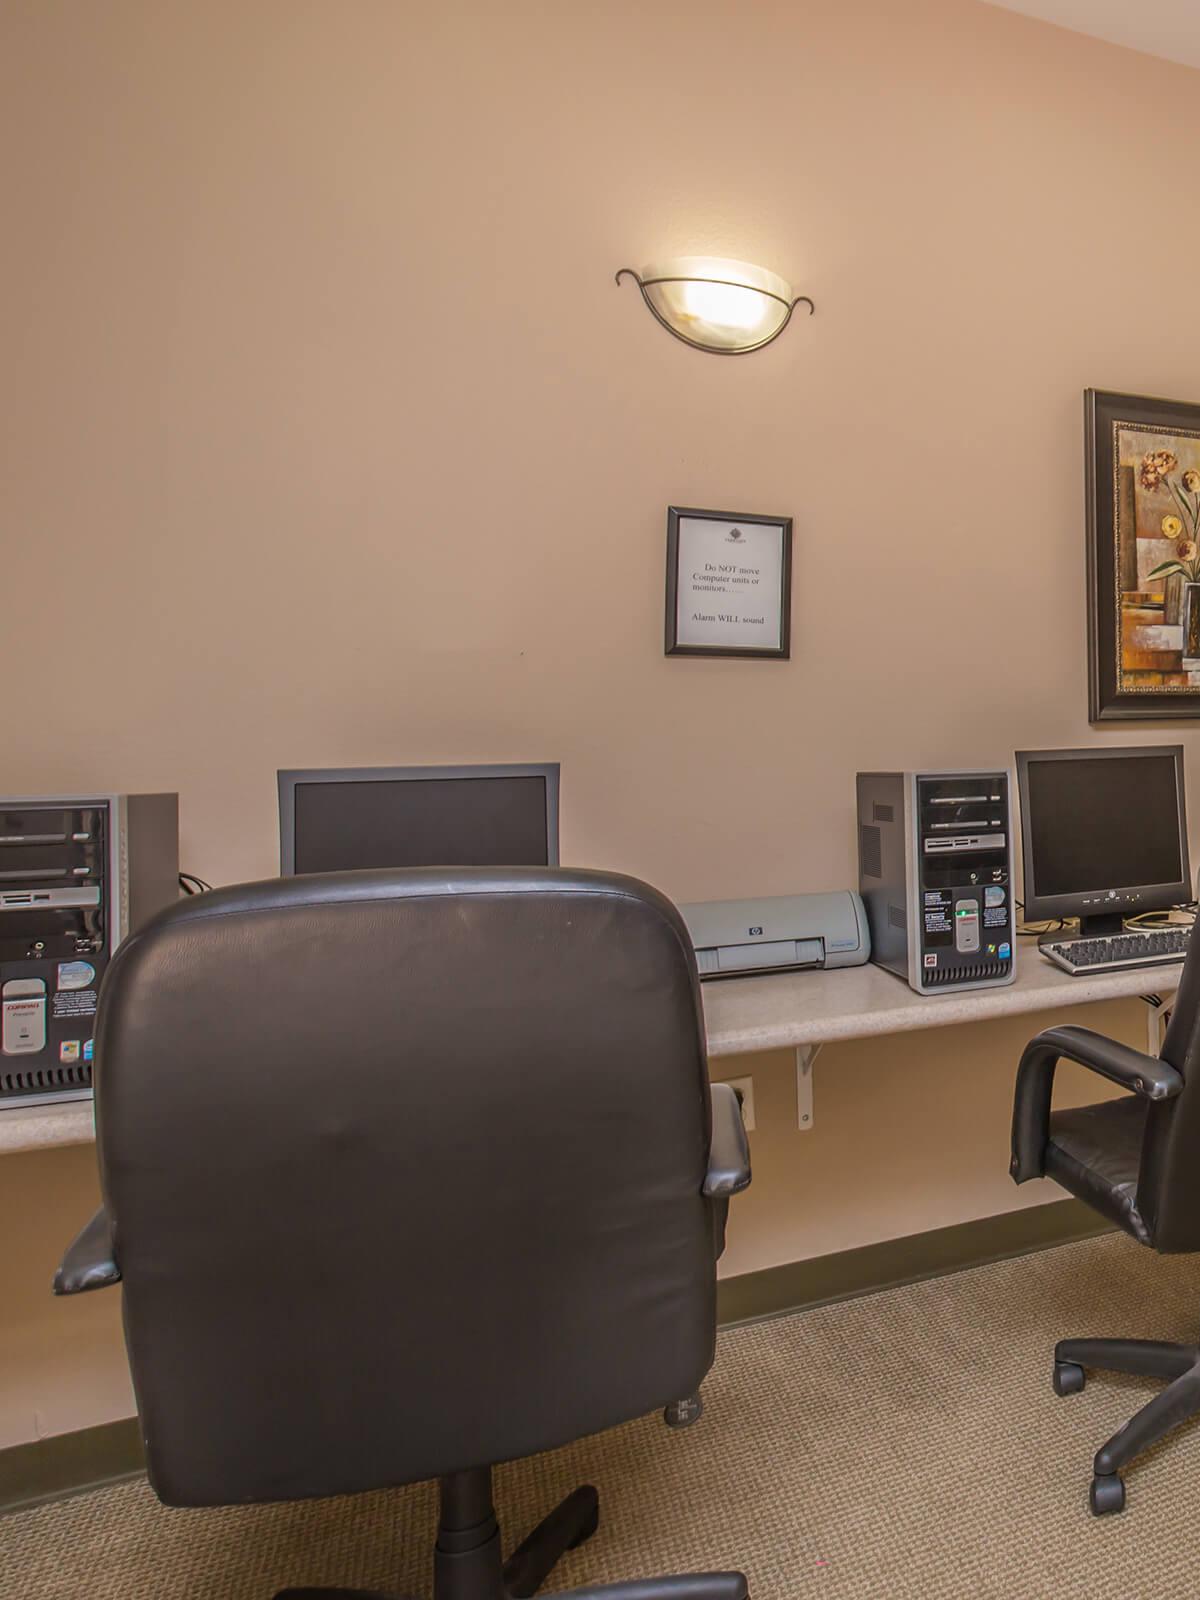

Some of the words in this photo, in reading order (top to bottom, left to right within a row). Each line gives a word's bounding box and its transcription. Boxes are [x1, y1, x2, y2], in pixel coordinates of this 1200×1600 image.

[705, 563, 716, 571] Do
[719, 564, 737, 573] NOT
[692, 573, 730, 583] Computer
[692, 612, 716, 621] Alarm
[718, 614, 739, 623] WILL
